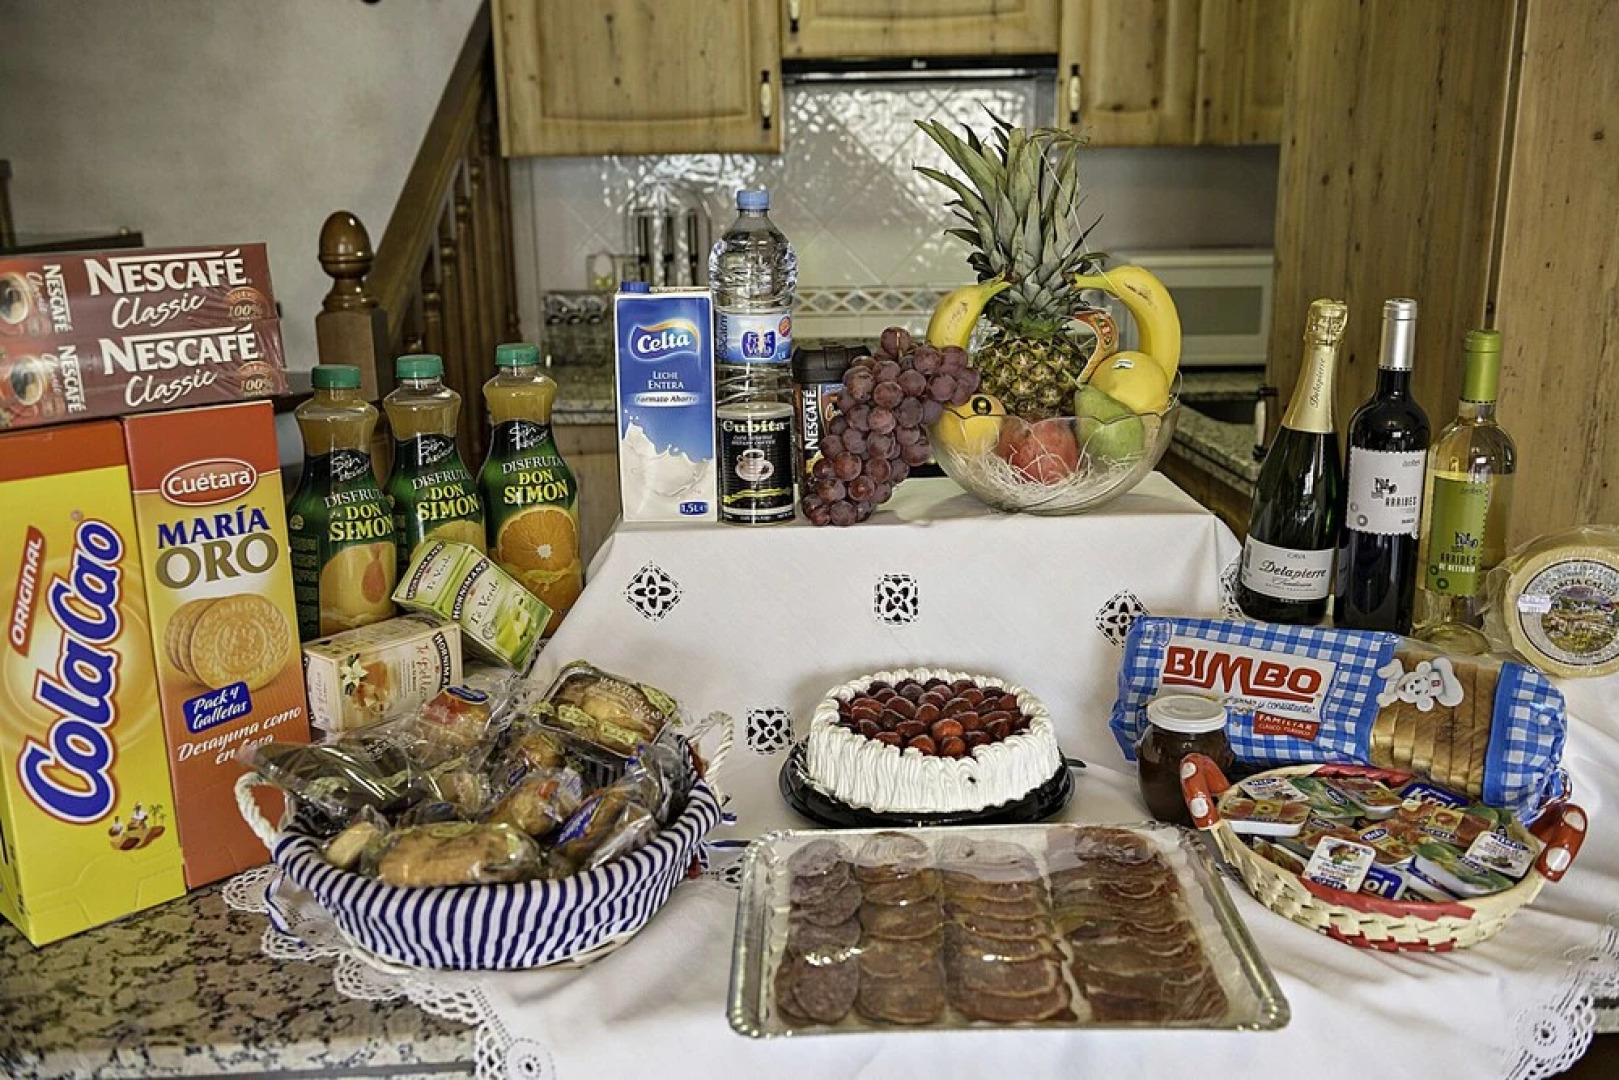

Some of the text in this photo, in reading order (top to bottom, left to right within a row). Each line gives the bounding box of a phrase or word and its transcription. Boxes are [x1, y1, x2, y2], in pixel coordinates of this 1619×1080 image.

[84, 249, 247, 295] NESCAFÉ
[43, 264, 73, 333] NESCAFÉ
[112, 293, 206, 329] Classic
[99, 324, 258, 375] NESCAFÉ
[637, 332, 690, 354] Celta
[58, 345, 87, 413] NESCAFÉ
[125, 369, 218, 407] Classic
[723, 420, 786, 433] Cubita
[167, 467, 251, 496] Cuétara
[431, 482, 466, 501] DON
[519, 469, 555, 485] DON
[417, 493, 479, 520] SIMON
[503, 479, 569, 505] SIMON
[345, 502, 382, 520] DON
[158, 505, 271, 549] MARÍA
[329, 514, 394, 542] SIMON
[156, 532, 278, 589] ORO
[1259, 559, 1327, 580] Delapierre
[12, 537, 42, 646] ORIGINAL
[452, 561, 488, 620] HORNIMANS
[434, 634, 450, 686] HORNIMA
[1163, 646, 1322, 700] BIMBO
[192, 701, 247, 730] Galletas
[193, 688, 228, 714] Pack
[178, 707, 301, 761] Desayuna como
[1259, 713, 1312, 731] FAMILIAR
[215, 748, 235, 764] en
